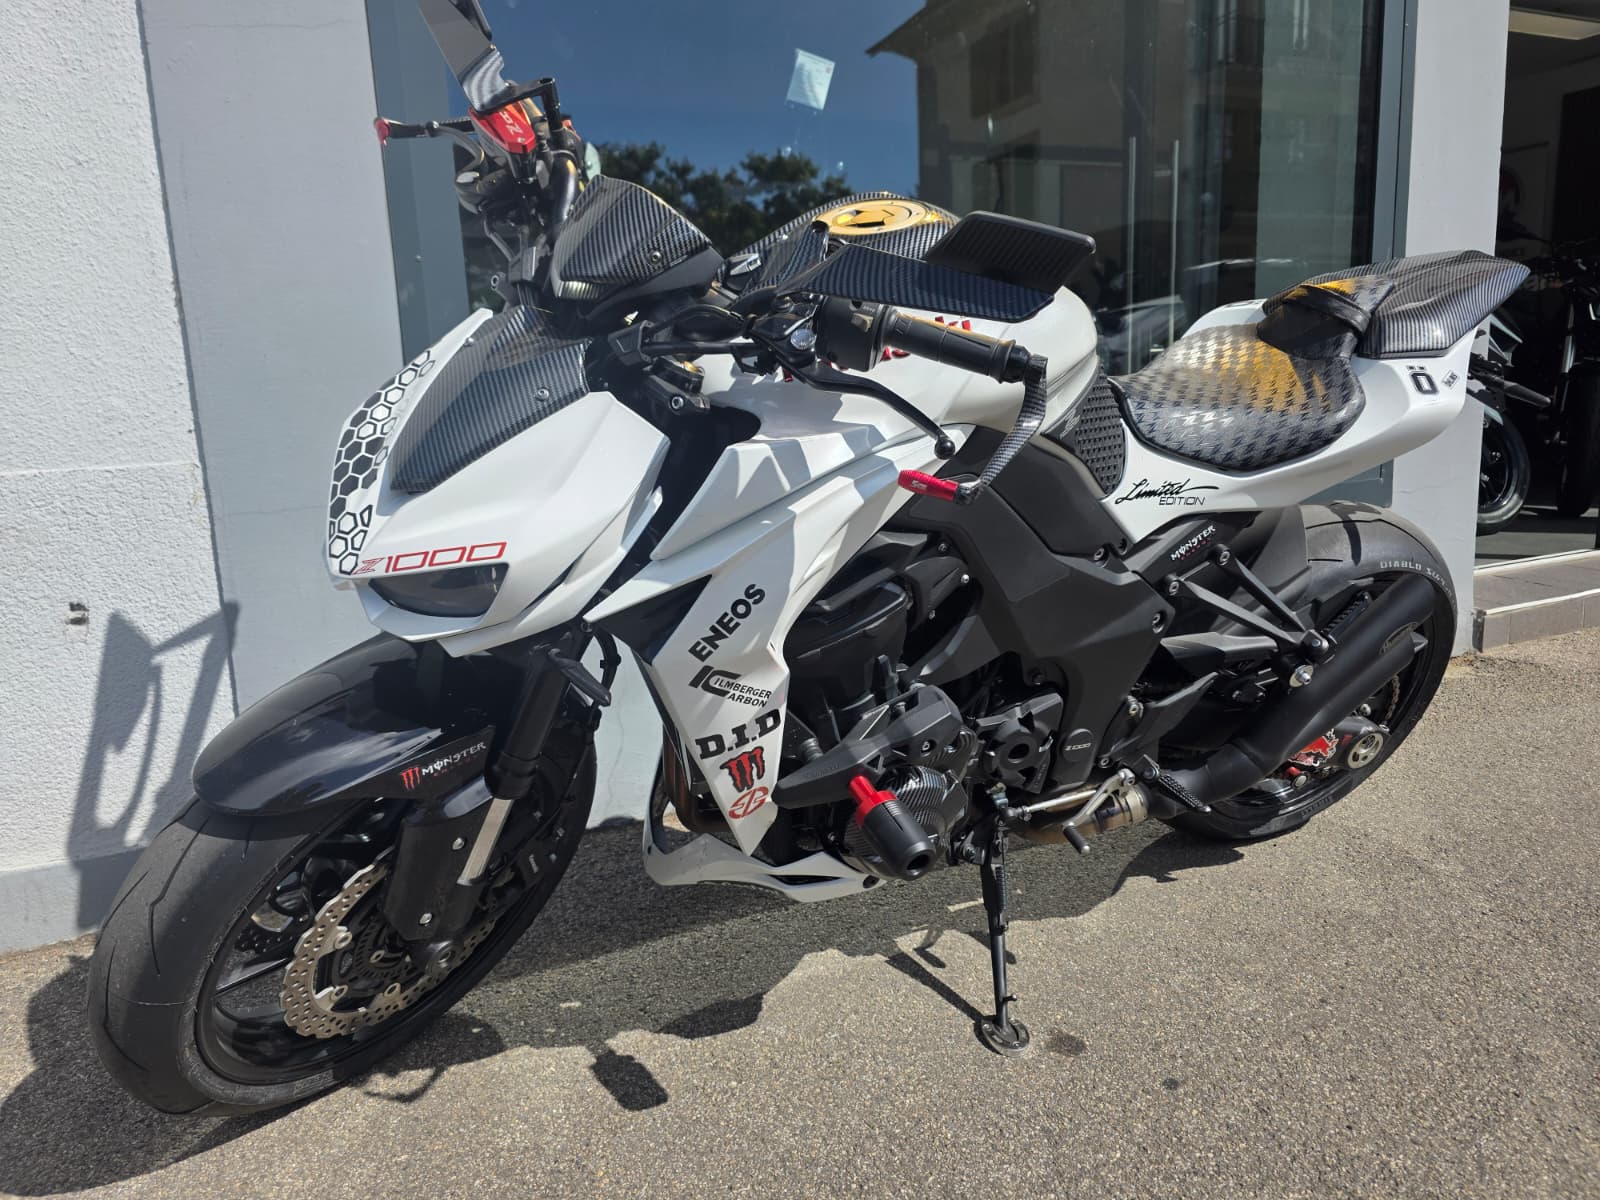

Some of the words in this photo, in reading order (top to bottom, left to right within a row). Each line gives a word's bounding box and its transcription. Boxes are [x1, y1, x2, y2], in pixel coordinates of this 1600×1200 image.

[1115, 478, 1219, 504] Limited
[1159, 496, 1205, 506] EDITION
[352, 541, 508, 575] Z1000
[1380, 560, 1422, 571] DIABLO
[688, 583, 766, 663] ENEOS
[695, 708, 781, 760] D.I.D
[421, 741, 487, 776] MONSTER
